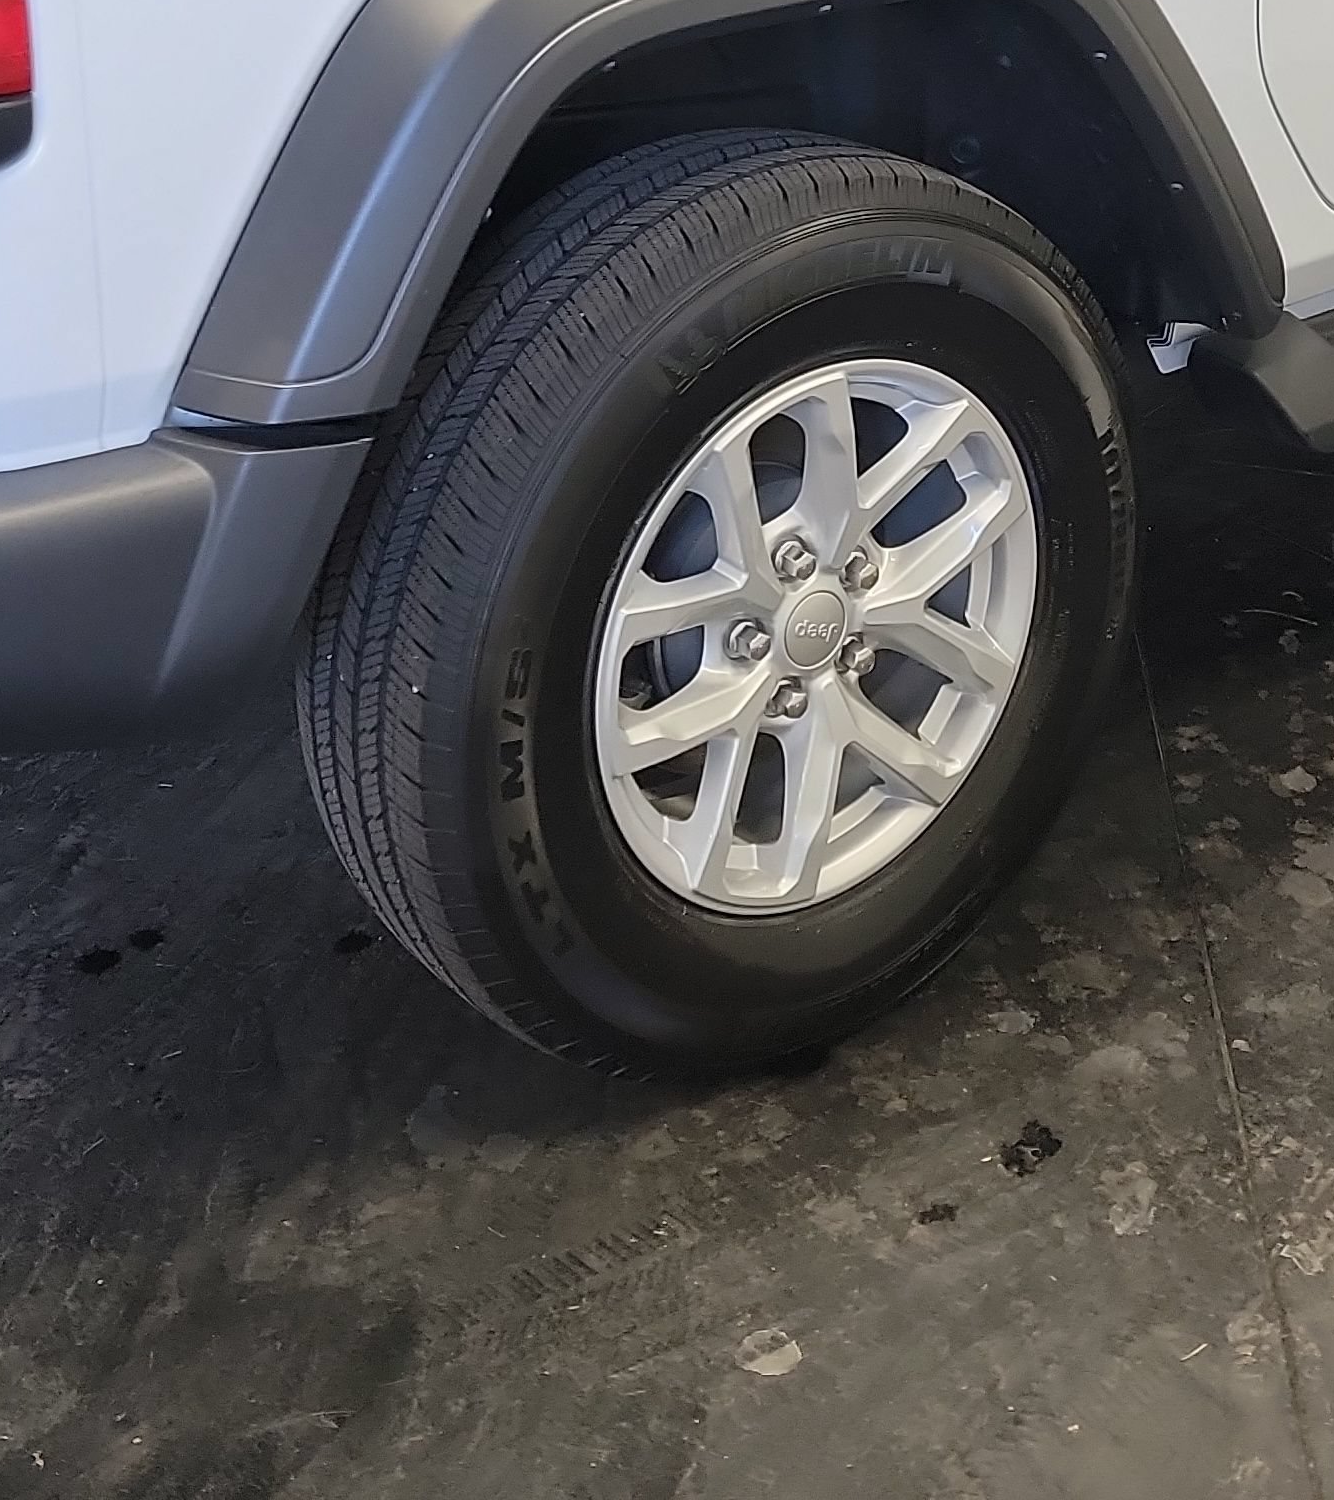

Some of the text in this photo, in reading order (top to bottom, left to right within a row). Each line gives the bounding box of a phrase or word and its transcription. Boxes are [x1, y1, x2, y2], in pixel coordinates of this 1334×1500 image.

[794, 619, 839, 643] Jeep
[500, 647, 574, 957] LTX M/S
